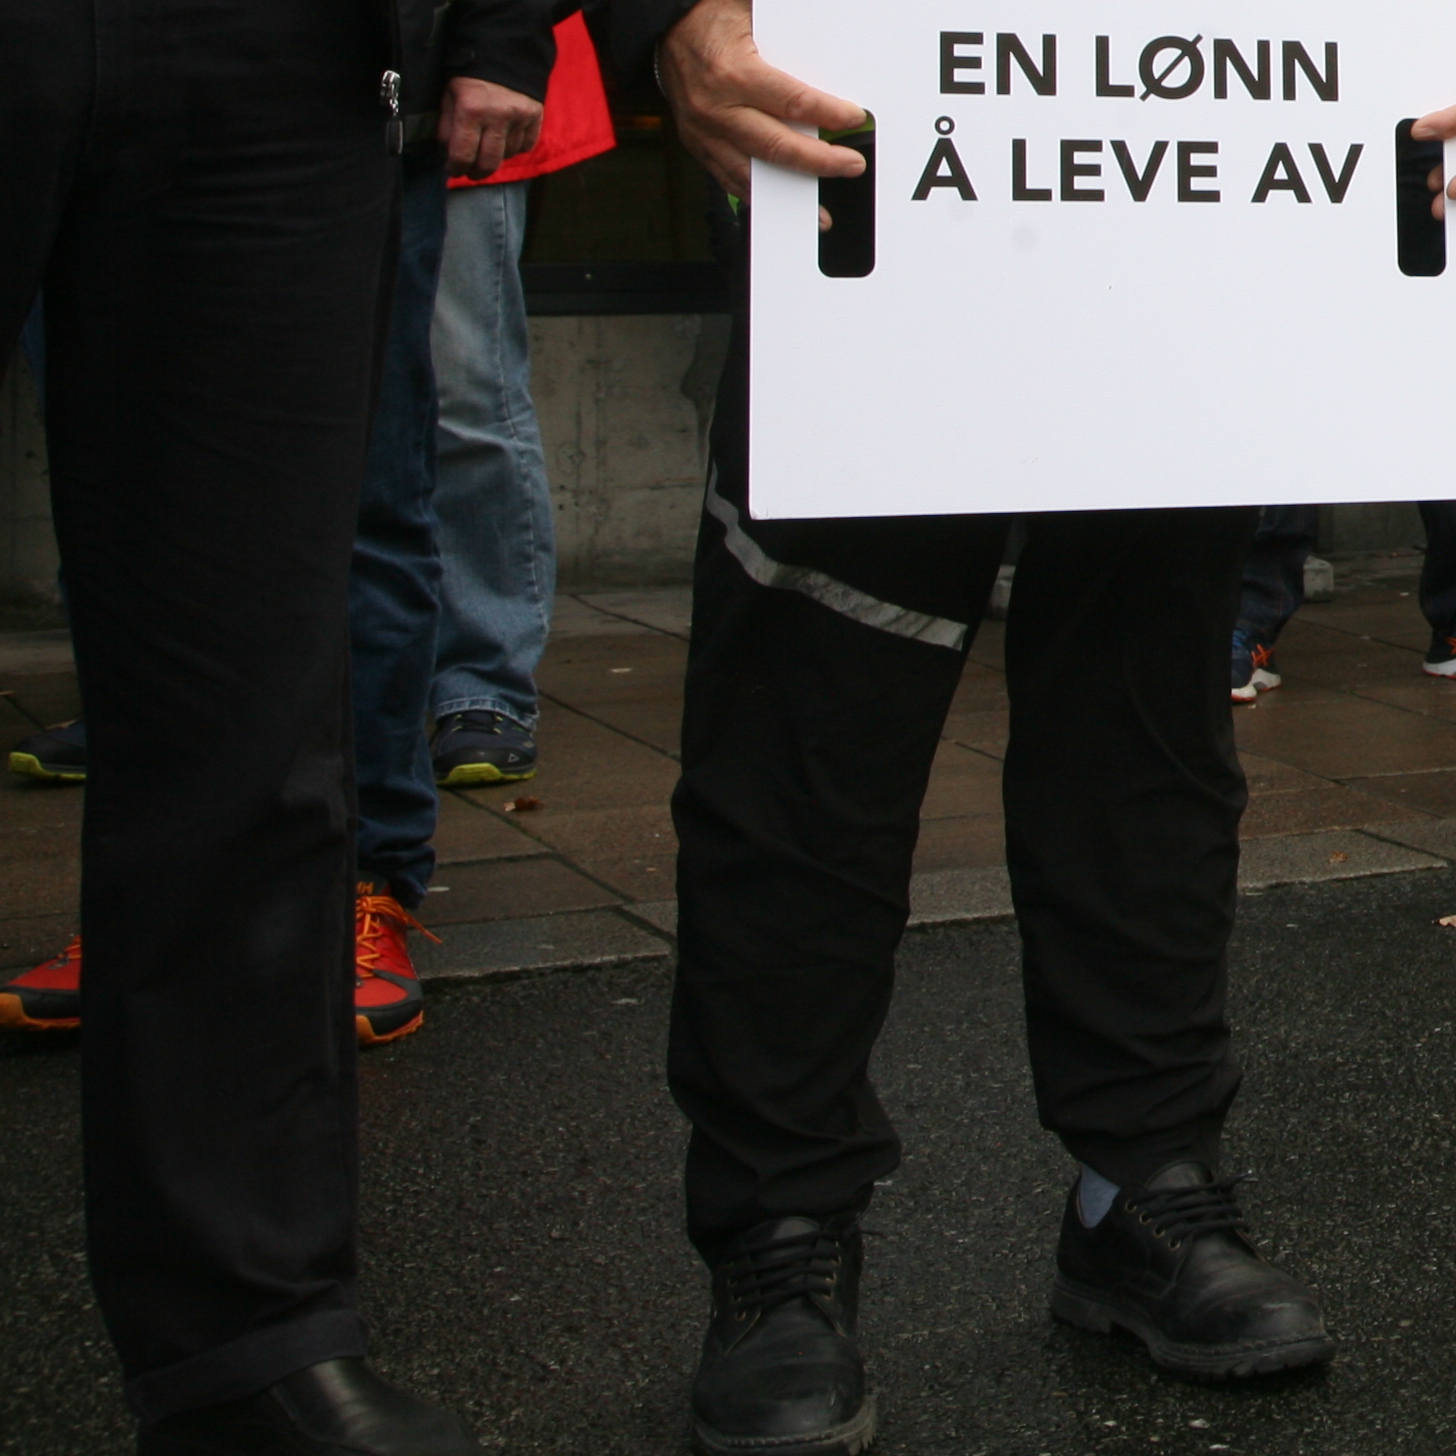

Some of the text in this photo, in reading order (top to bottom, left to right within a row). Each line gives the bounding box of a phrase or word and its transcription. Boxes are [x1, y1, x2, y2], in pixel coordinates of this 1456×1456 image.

[940, 31, 1340, 103] EN LØNN
[911, 116, 1365, 204] Å LEVE AV
